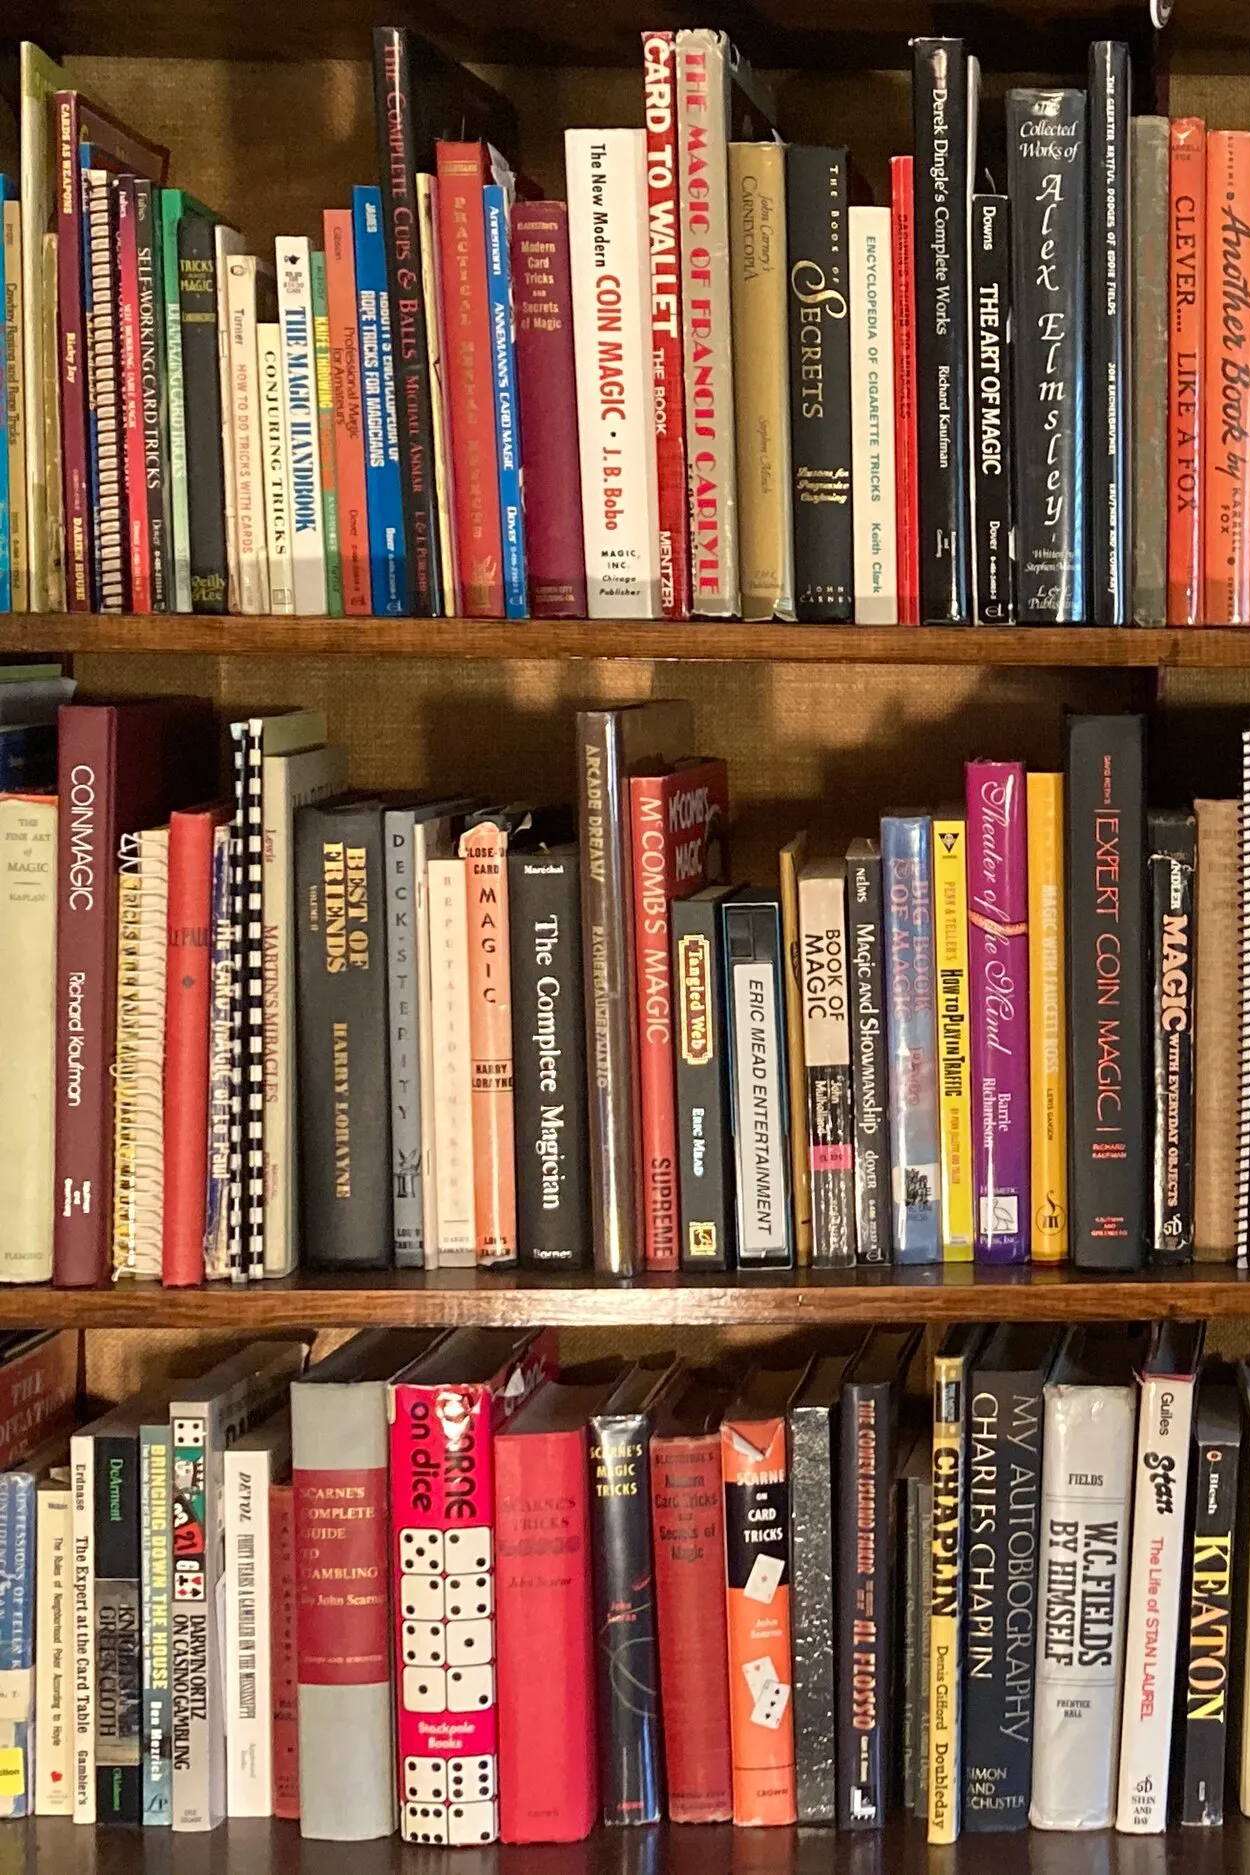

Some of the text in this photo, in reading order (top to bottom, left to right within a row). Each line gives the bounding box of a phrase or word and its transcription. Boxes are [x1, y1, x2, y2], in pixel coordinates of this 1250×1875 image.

[59, 103, 73, 214] CARDS AS WEAPONS
[384, 41, 419, 359] THE COMPLETE CUPS & BALLS
[643, 38, 678, 339] CARD TO WALLET
[931, 88, 951, 335] Derek Dingle's Complete Works
[983, 206, 996, 250] Downs
[590, 144, 625, 422] The New Modern COIN MAGIC
[684, 51, 721, 596] THE MAGIC OF FRANCIS CARLYLE
[137, 247, 161, 489] SELF-WORKING CARD TRICKS
[283, 306, 316, 533] THE MAGIC HANDBOOK
[865, 236, 882, 502] ENCYCLOPEDIA OF CIGARETTE TRICKS
[979, 284, 1001, 475] THE ART OF MAGIC
[603, 447, 624, 531] J. B. Bobo
[1215, 451, 1248, 480] by
[659, 531, 674, 608] MENTZER
[69, 765, 95, 911] COINMAGIC
[323, 841, 346, 974] FRIENDS
[343, 848, 369, 970] BEST OF
[65, 972, 85, 1107] Richard Kaufman
[645, 949, 670, 1044] MAGIC
[805, 933, 827, 1021] MAGIC
[825, 929, 843, 1022] BOOK OF
[1094, 817, 1122, 1121] EXPERT COIN MAGIC
[332, 1022, 351, 1199] HARRY LORAYNE
[532, 915, 565, 1209] The Complete Magician
[747, 978, 773, 1235] ERIC MEAD ENTERTAINMENT
[1160, 914, 1187, 1207] MAGIC WITH EVERYDAY OBJECTS
[75, 1464, 88, 1511] Erdnase
[107, 1459, 124, 1521] DeArment
[410, 1402, 437, 1512] on dice
[1143, 1452, 1176, 1515] Stan
[1159, 1392, 1173, 1436] Guiles
[744, 1528, 783, 1543] TRICKS
[931, 1447, 960, 1619] CHAPLIN
[968, 1392, 998, 1680] CHARLES CHAPLIN
[999, 1393, 1038, 1744] MY AUTOBIOGRAPHY
[1043, 1519, 1078, 1667] BY HIMSELF
[73, 1536, 91, 1734] The Expert at the Card Table
[1077, 1574, 1117, 1667] FIELDS
[1139, 1537, 1164, 1722] The Life of STAN LAUREL
[1186, 1530, 1232, 1723] KEATON
